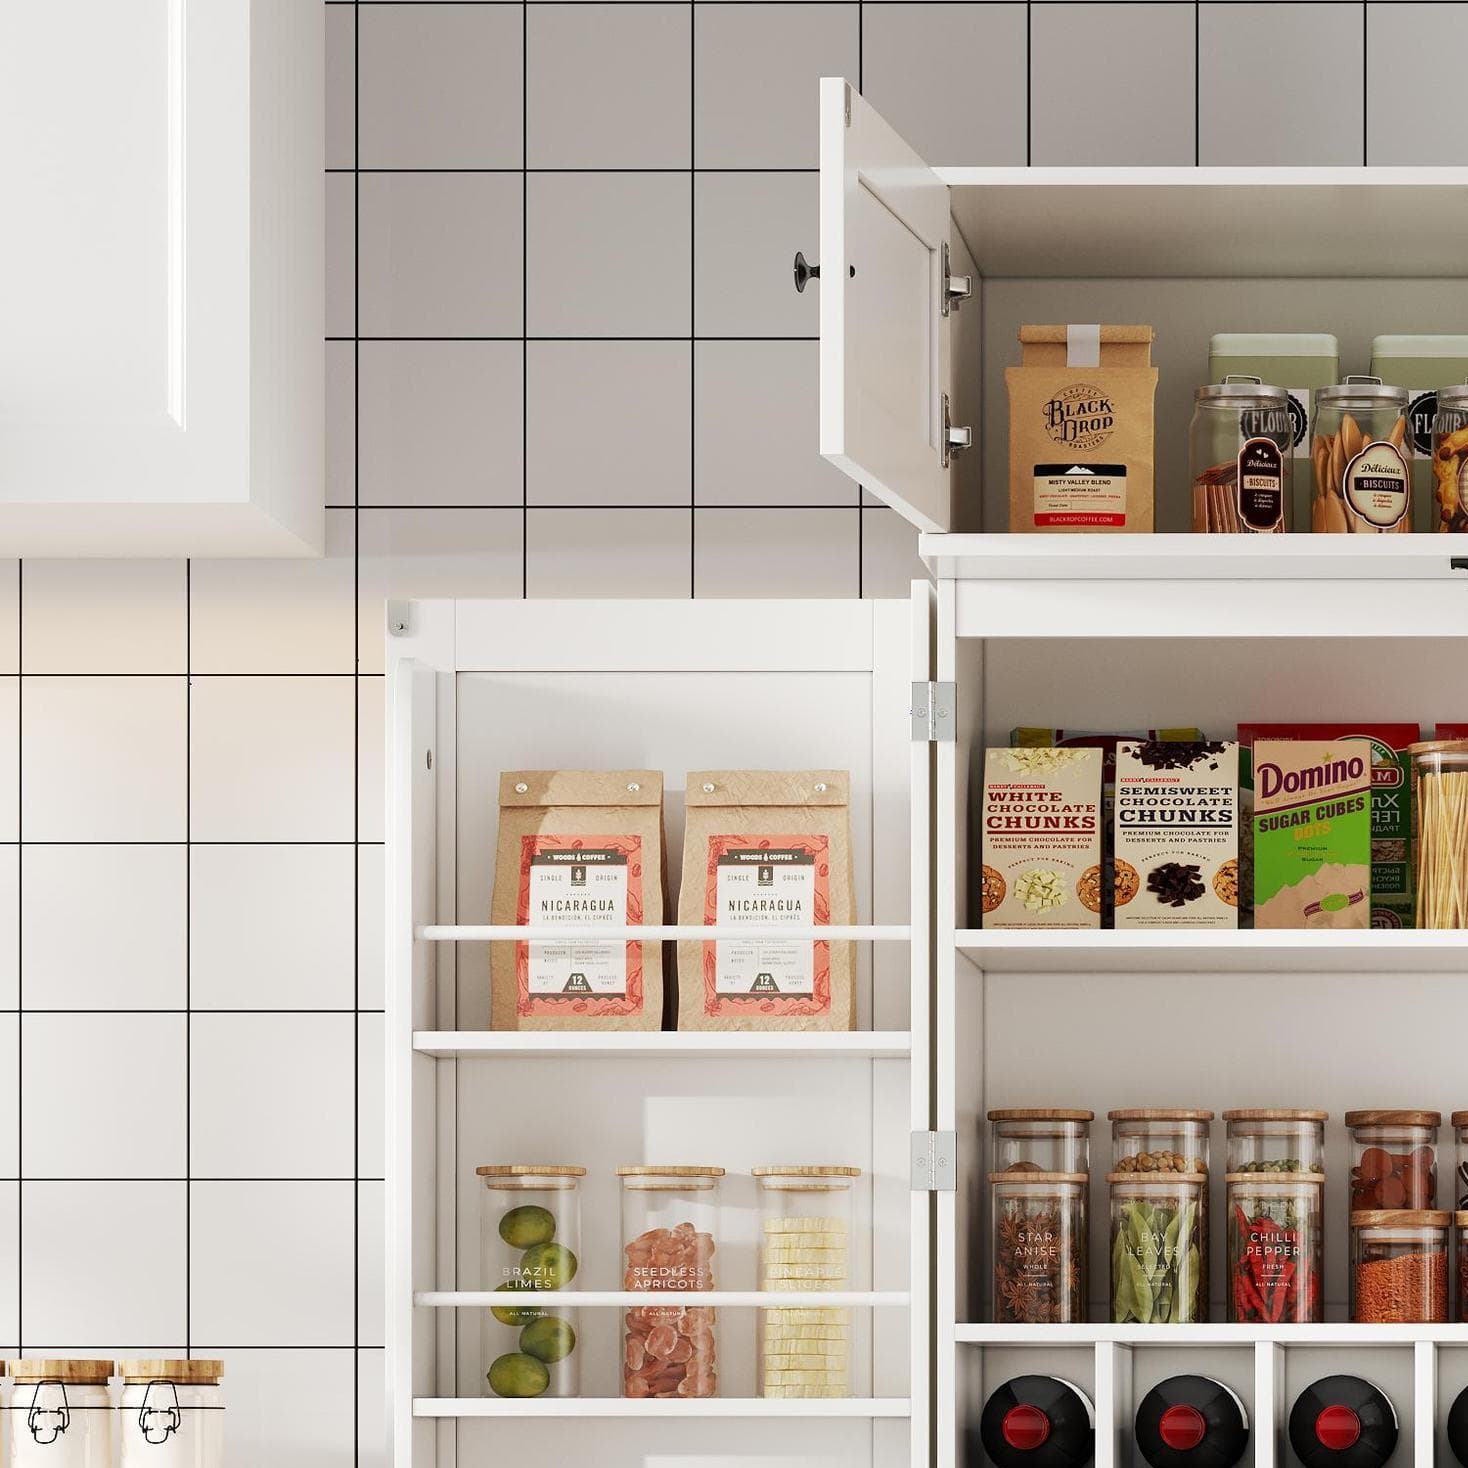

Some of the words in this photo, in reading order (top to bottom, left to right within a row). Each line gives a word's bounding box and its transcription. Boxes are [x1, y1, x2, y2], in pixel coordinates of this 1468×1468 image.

[1042, 399, 1116, 427] BLACK
[1251, 411, 1297, 433] FLOUR
[1054, 416, 1113, 442] DROP
[1248, 479, 1276, 488] BISCUITS
[1363, 480, 1399, 490] BISCUITS
[1257, 757, 1364, 798] Domino
[1120, 787, 1232, 795] SEMISWEET
[988, 792, 1062, 801] WHITE
[1120, 798, 1232, 806] CHOCOLATE
[1120, 810, 1232, 822] CHUNKS
[1259, 810, 1310, 833] SUGAR
[1316, 797, 1365, 820] CUBES
[987, 816, 1096, 828] CHUNKS
[541, 900, 614, 911] NICARAGUA
[728, 900, 802, 911] NICARAGUA
[572, 975, 583, 984] 12
[759, 975, 770, 984] 12
[1018, 1232, 1053, 1242] STAR
[1141, 1232, 1167, 1242] BAY
[1250, 1232, 1296, 1242] CHILLI
[1015, 1246, 1056, 1256] ANISE
[1128, 1246, 1181, 1256] LEAVES
[1247, 1246, 1300, 1256] PEPPER
[503, 1267, 556, 1276] BRAZIL
[634, 1267, 704, 1276] SEEDLESS
[507, 1280, 552, 1288] LIMES
[635, 1280, 704, 1289] APRICOTS
